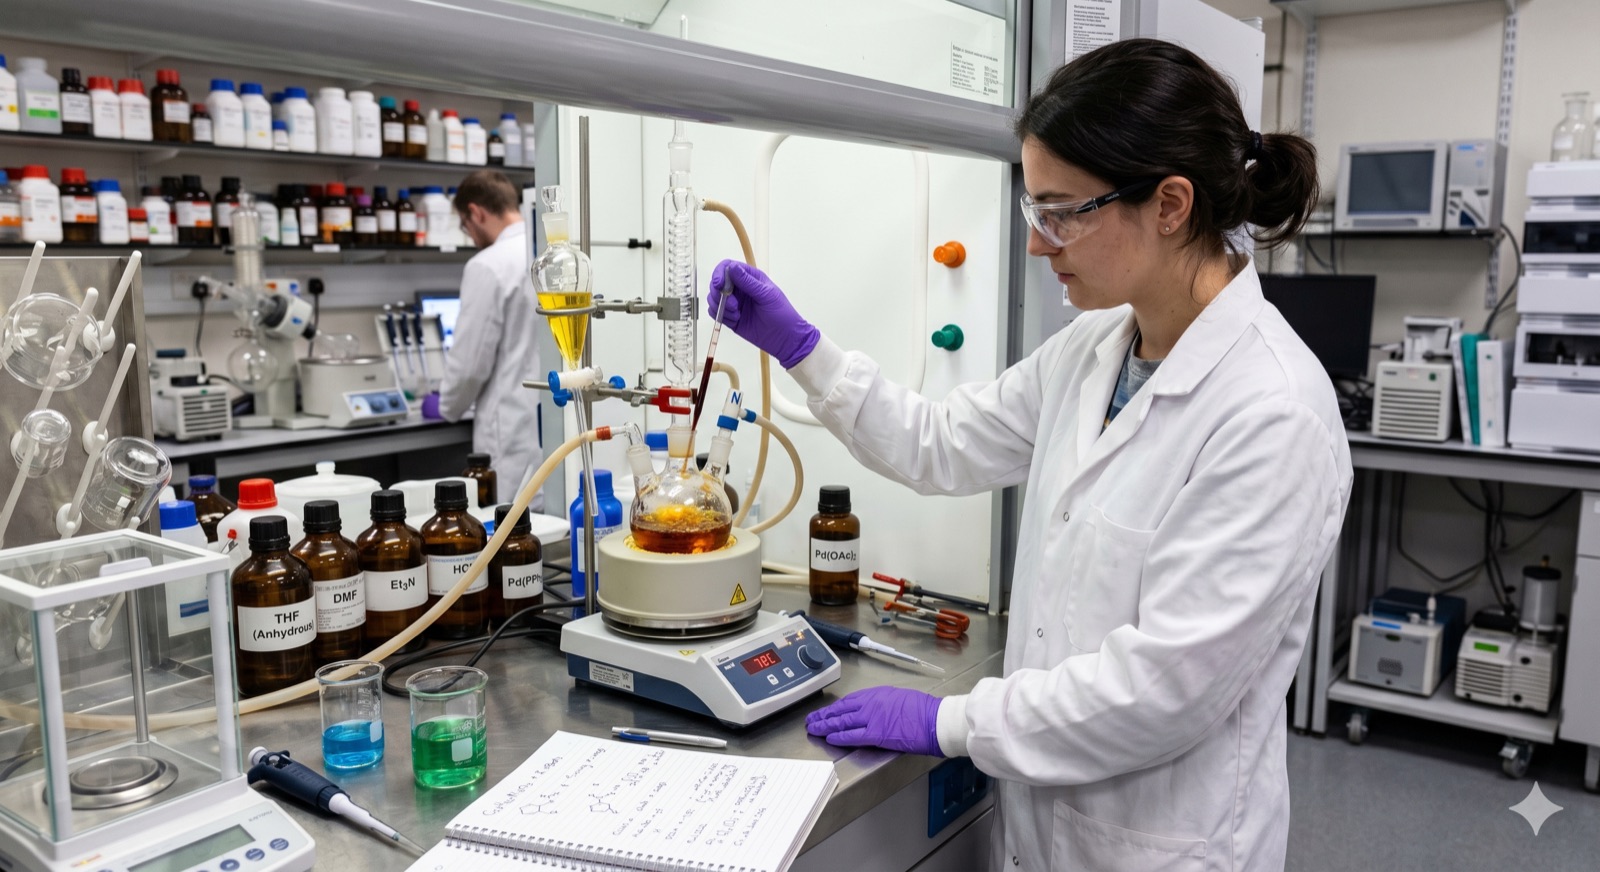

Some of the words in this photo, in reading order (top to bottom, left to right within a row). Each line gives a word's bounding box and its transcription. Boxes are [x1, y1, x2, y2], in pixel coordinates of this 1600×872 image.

[333, 589, 358, 604] DMF
[274, 610, 300, 625] THF
[252, 619, 315, 641] (Anhydrous)
